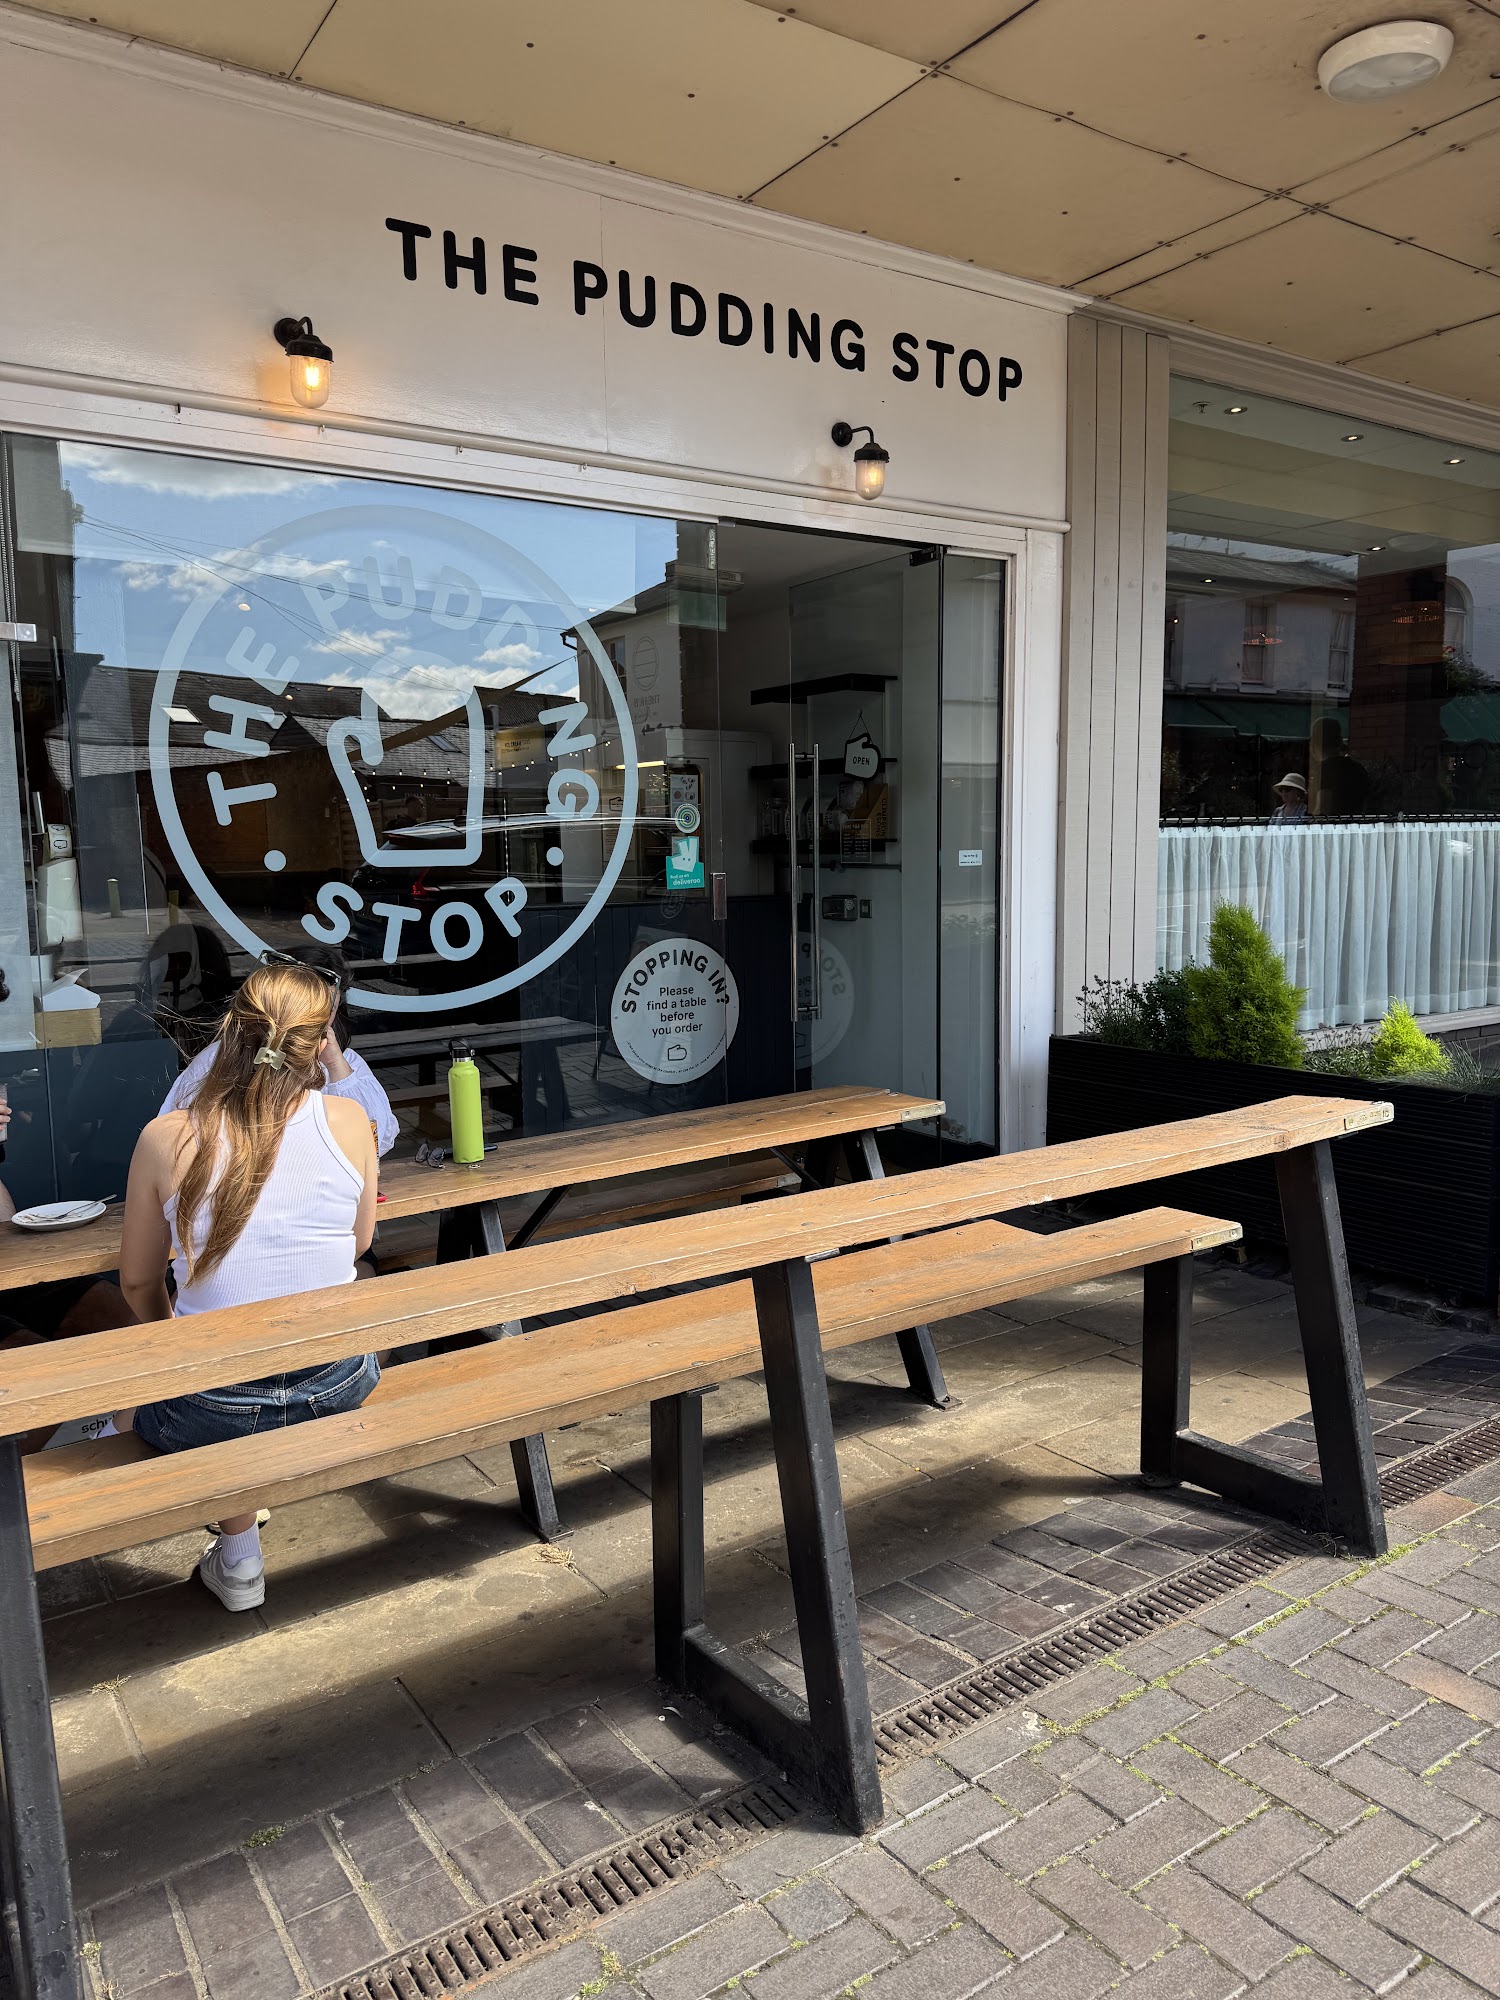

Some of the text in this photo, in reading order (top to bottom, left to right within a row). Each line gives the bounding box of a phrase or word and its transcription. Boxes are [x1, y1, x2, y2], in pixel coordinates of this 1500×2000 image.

[385, 217, 1023, 403] THE PUDDING STOP
[203, 626, 300, 827] THE
[852, 756, 870, 766] OPEN
[673, 878, 701, 886] deliveroo
[300, 876, 528, 965] STOP
[621, 949, 730, 1014] STOPPING IN?
[659, 985, 694, 997] Please
[646, 997, 707, 1011] find a table
[660, 1011, 695, 1023] before
[652, 1022, 703, 1038] you order
